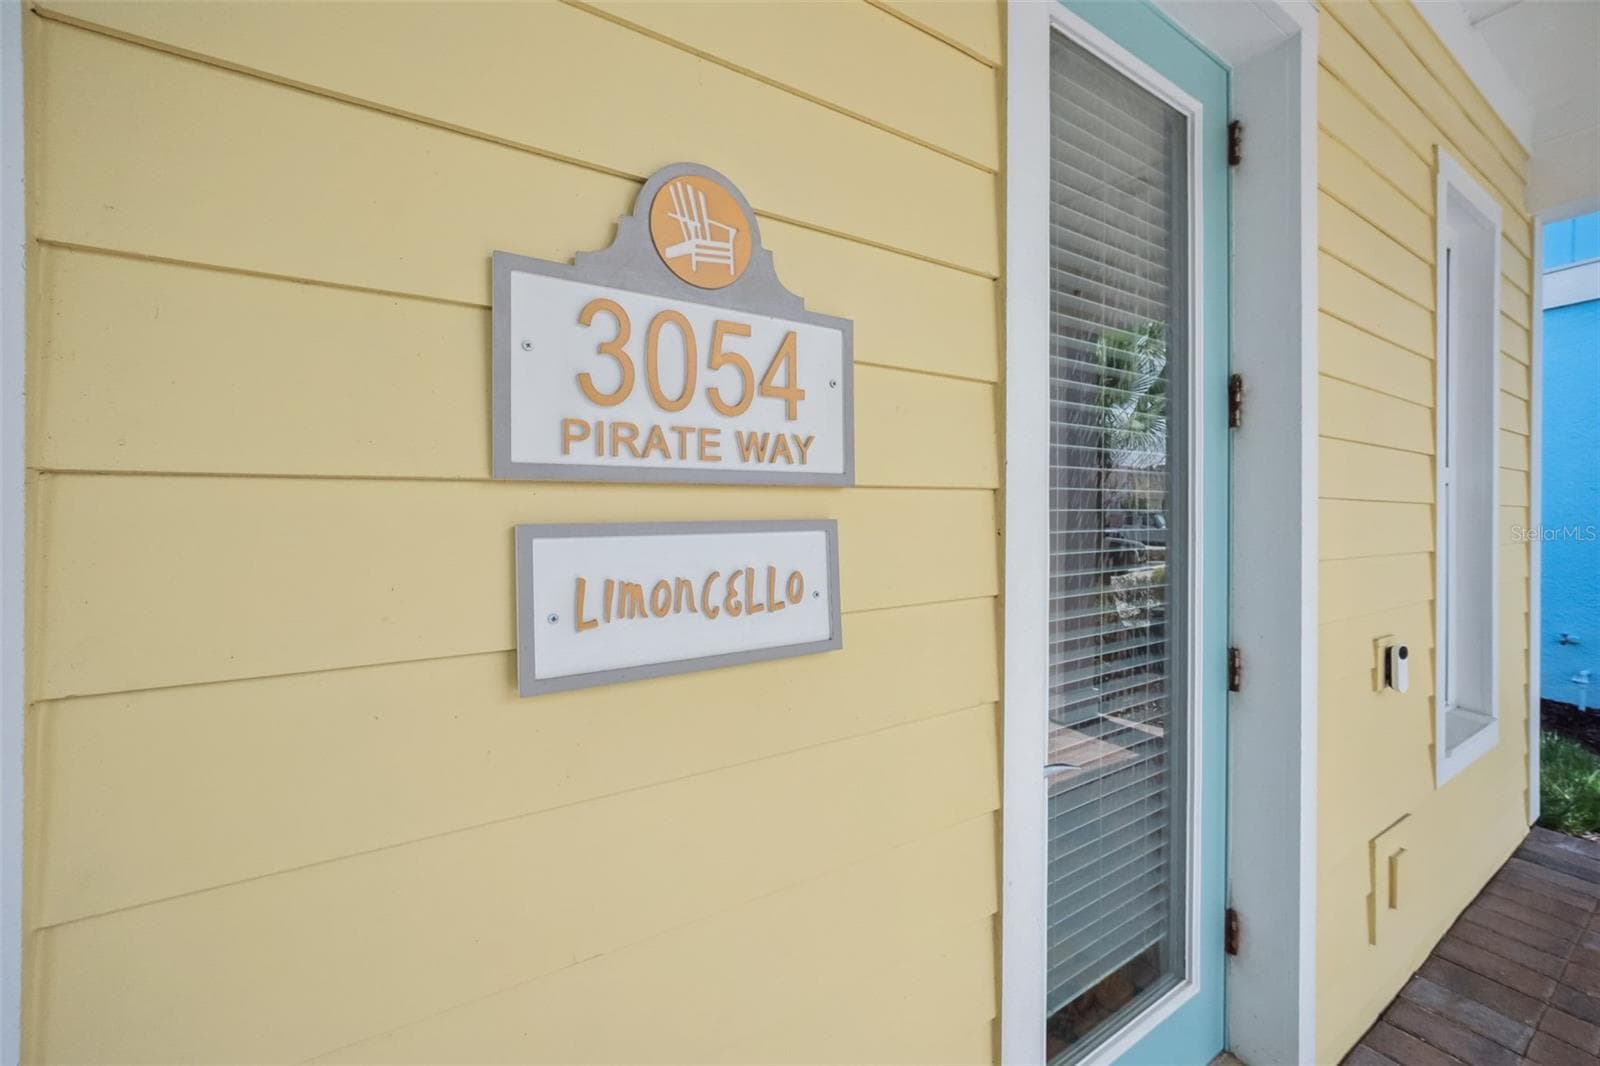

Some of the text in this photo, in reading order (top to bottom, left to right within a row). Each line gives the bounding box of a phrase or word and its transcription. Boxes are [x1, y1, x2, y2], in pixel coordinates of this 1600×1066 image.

[577, 298, 806, 421] 3054
[561, 417, 815, 465] PIRATE WAY
